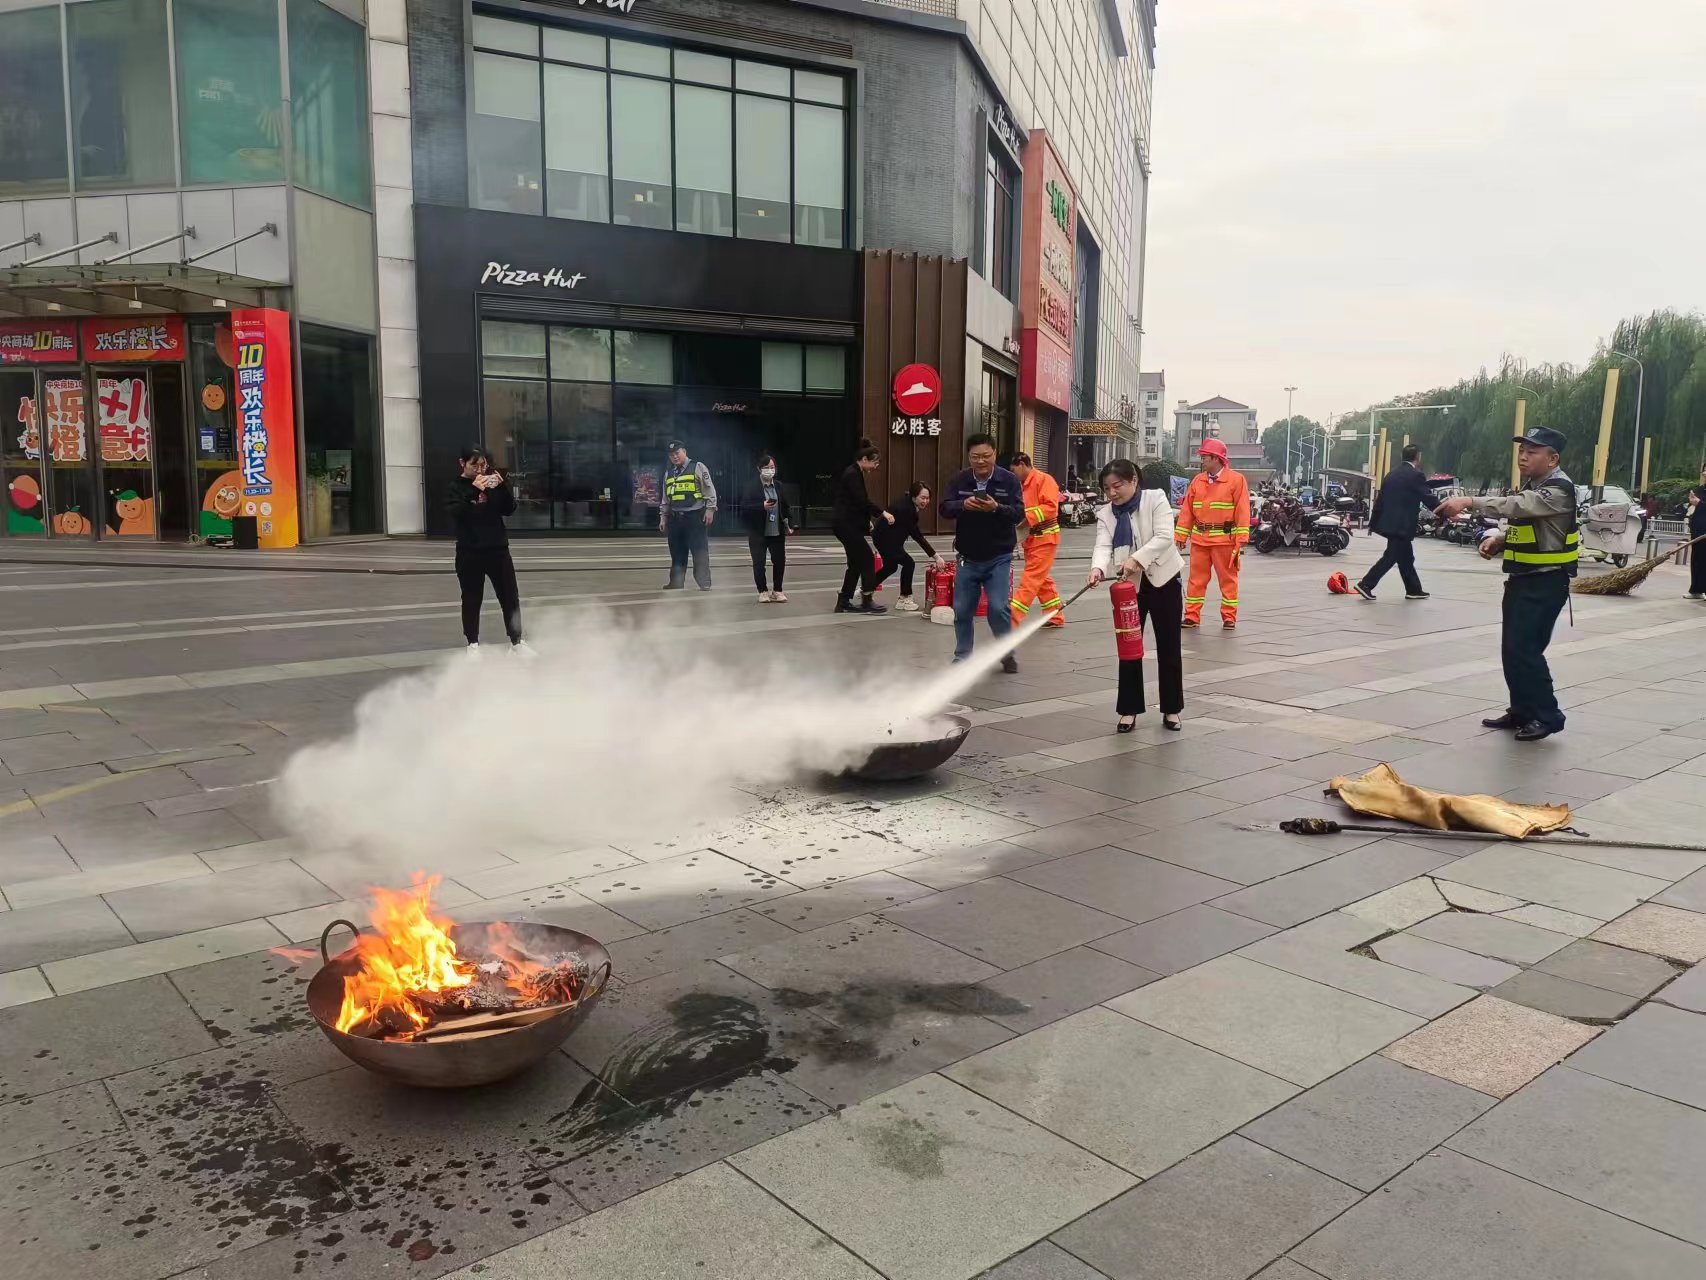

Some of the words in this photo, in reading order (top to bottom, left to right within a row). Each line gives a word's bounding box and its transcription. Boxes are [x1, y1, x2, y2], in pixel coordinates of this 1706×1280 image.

[481, 261, 541, 286] Pizza
[542, 267, 587, 289] Hut
[0, 330, 73, 351] 央商场10周年
[95, 326, 173, 351] 欢乐橙长
[238, 343, 264, 369] 10
[239, 369, 265, 385] 周年
[240, 386, 272, 485] 欢乐橙长
[892, 417, 942, 436] 必胜客
